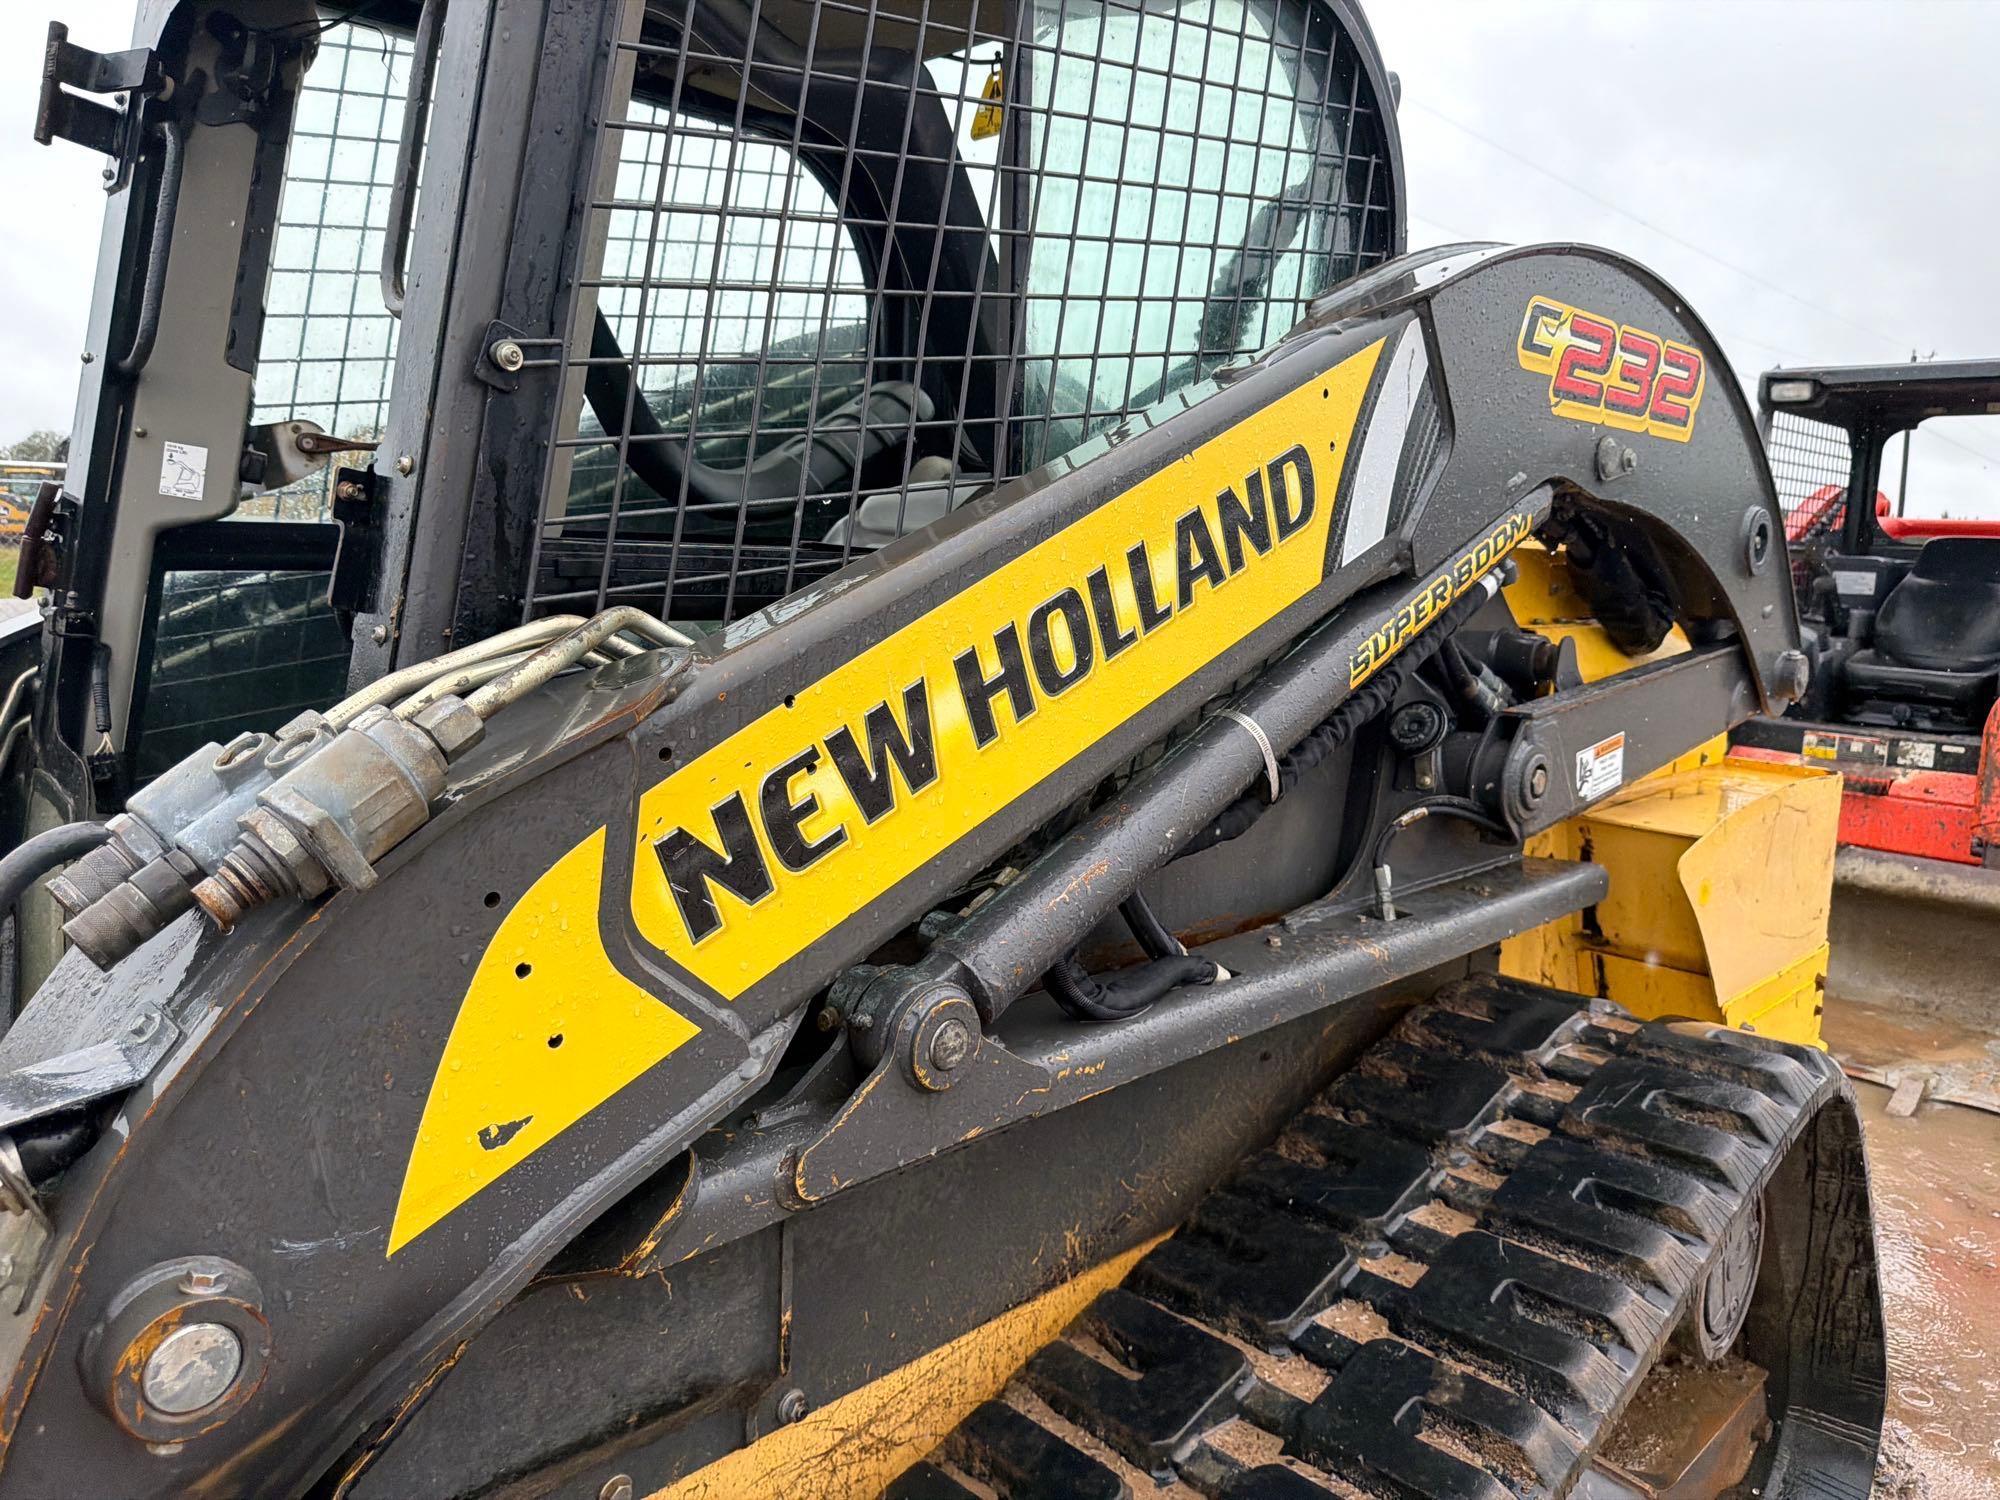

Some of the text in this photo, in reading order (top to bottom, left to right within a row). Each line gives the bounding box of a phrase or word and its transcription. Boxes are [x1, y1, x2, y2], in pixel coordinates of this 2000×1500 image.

[1520, 299, 1703, 431] C232
[1350, 513, 1533, 689] SUPER BOOM
[653, 443, 1316, 946] NEW HOLLAND
